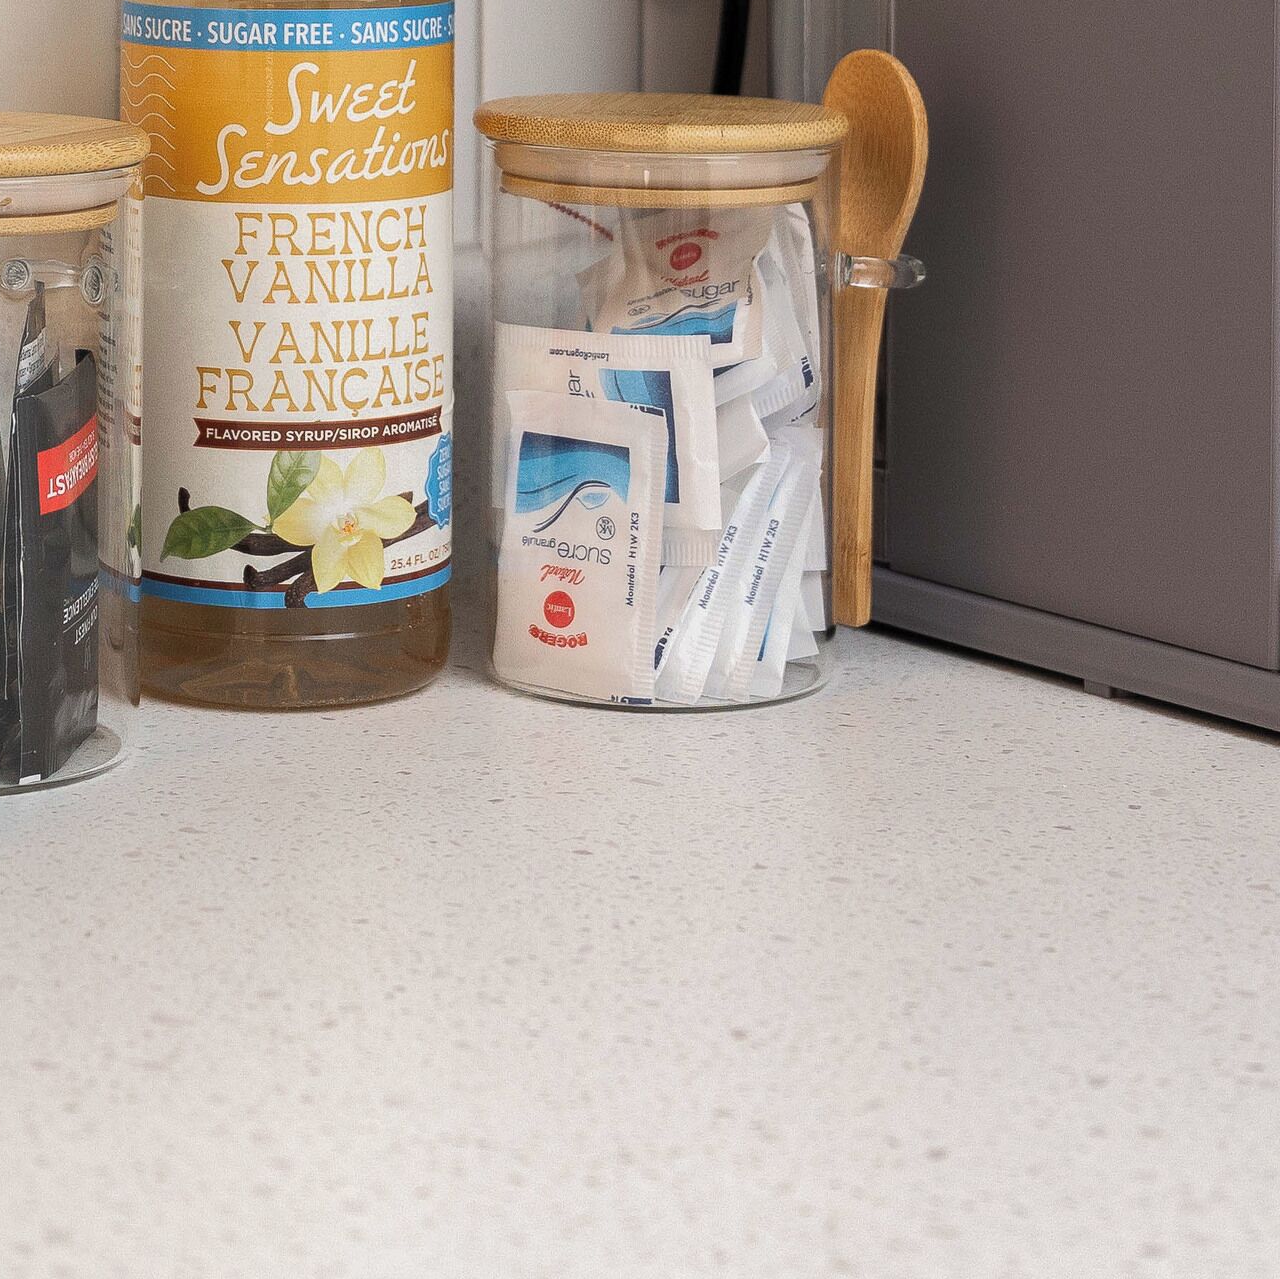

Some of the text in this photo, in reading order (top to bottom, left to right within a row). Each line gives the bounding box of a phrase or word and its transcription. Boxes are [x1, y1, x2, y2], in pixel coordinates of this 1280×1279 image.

[145, 17, 192, 42] SUCRE
[207, 20, 277, 45] SUGAR
[283, 22, 333, 45] FREE
[351, 21, 399, 45] SANS
[403, 17, 442, 41] SUCRE
[264, 58, 417, 136] Sweet
[195, 124, 450, 196] Sensations
[234, 204, 428, 256] FRENCH
[221, 252, 434, 304] VANILLA
[680, 279, 740, 300] sugar
[228, 311, 431, 365] VANILLE
[195, 353, 445, 418] FRANÇAISE
[206, 413, 438, 443] FLAVORED SYRUP/SIROP AROMATISÉ
[390, 556, 412, 570] 25.4
[558, 541, 612, 565] sucre
[625, 512, 640, 607] Montréal H1W 2K3
[698, 569, 720, 609] Montréal
[724, 525, 738, 543] 2K3
[744, 519, 780, 606] Montréal H1W 2K3
[528, 623, 589, 648] ROGERS
[546, 602, 572, 617] Lantic
